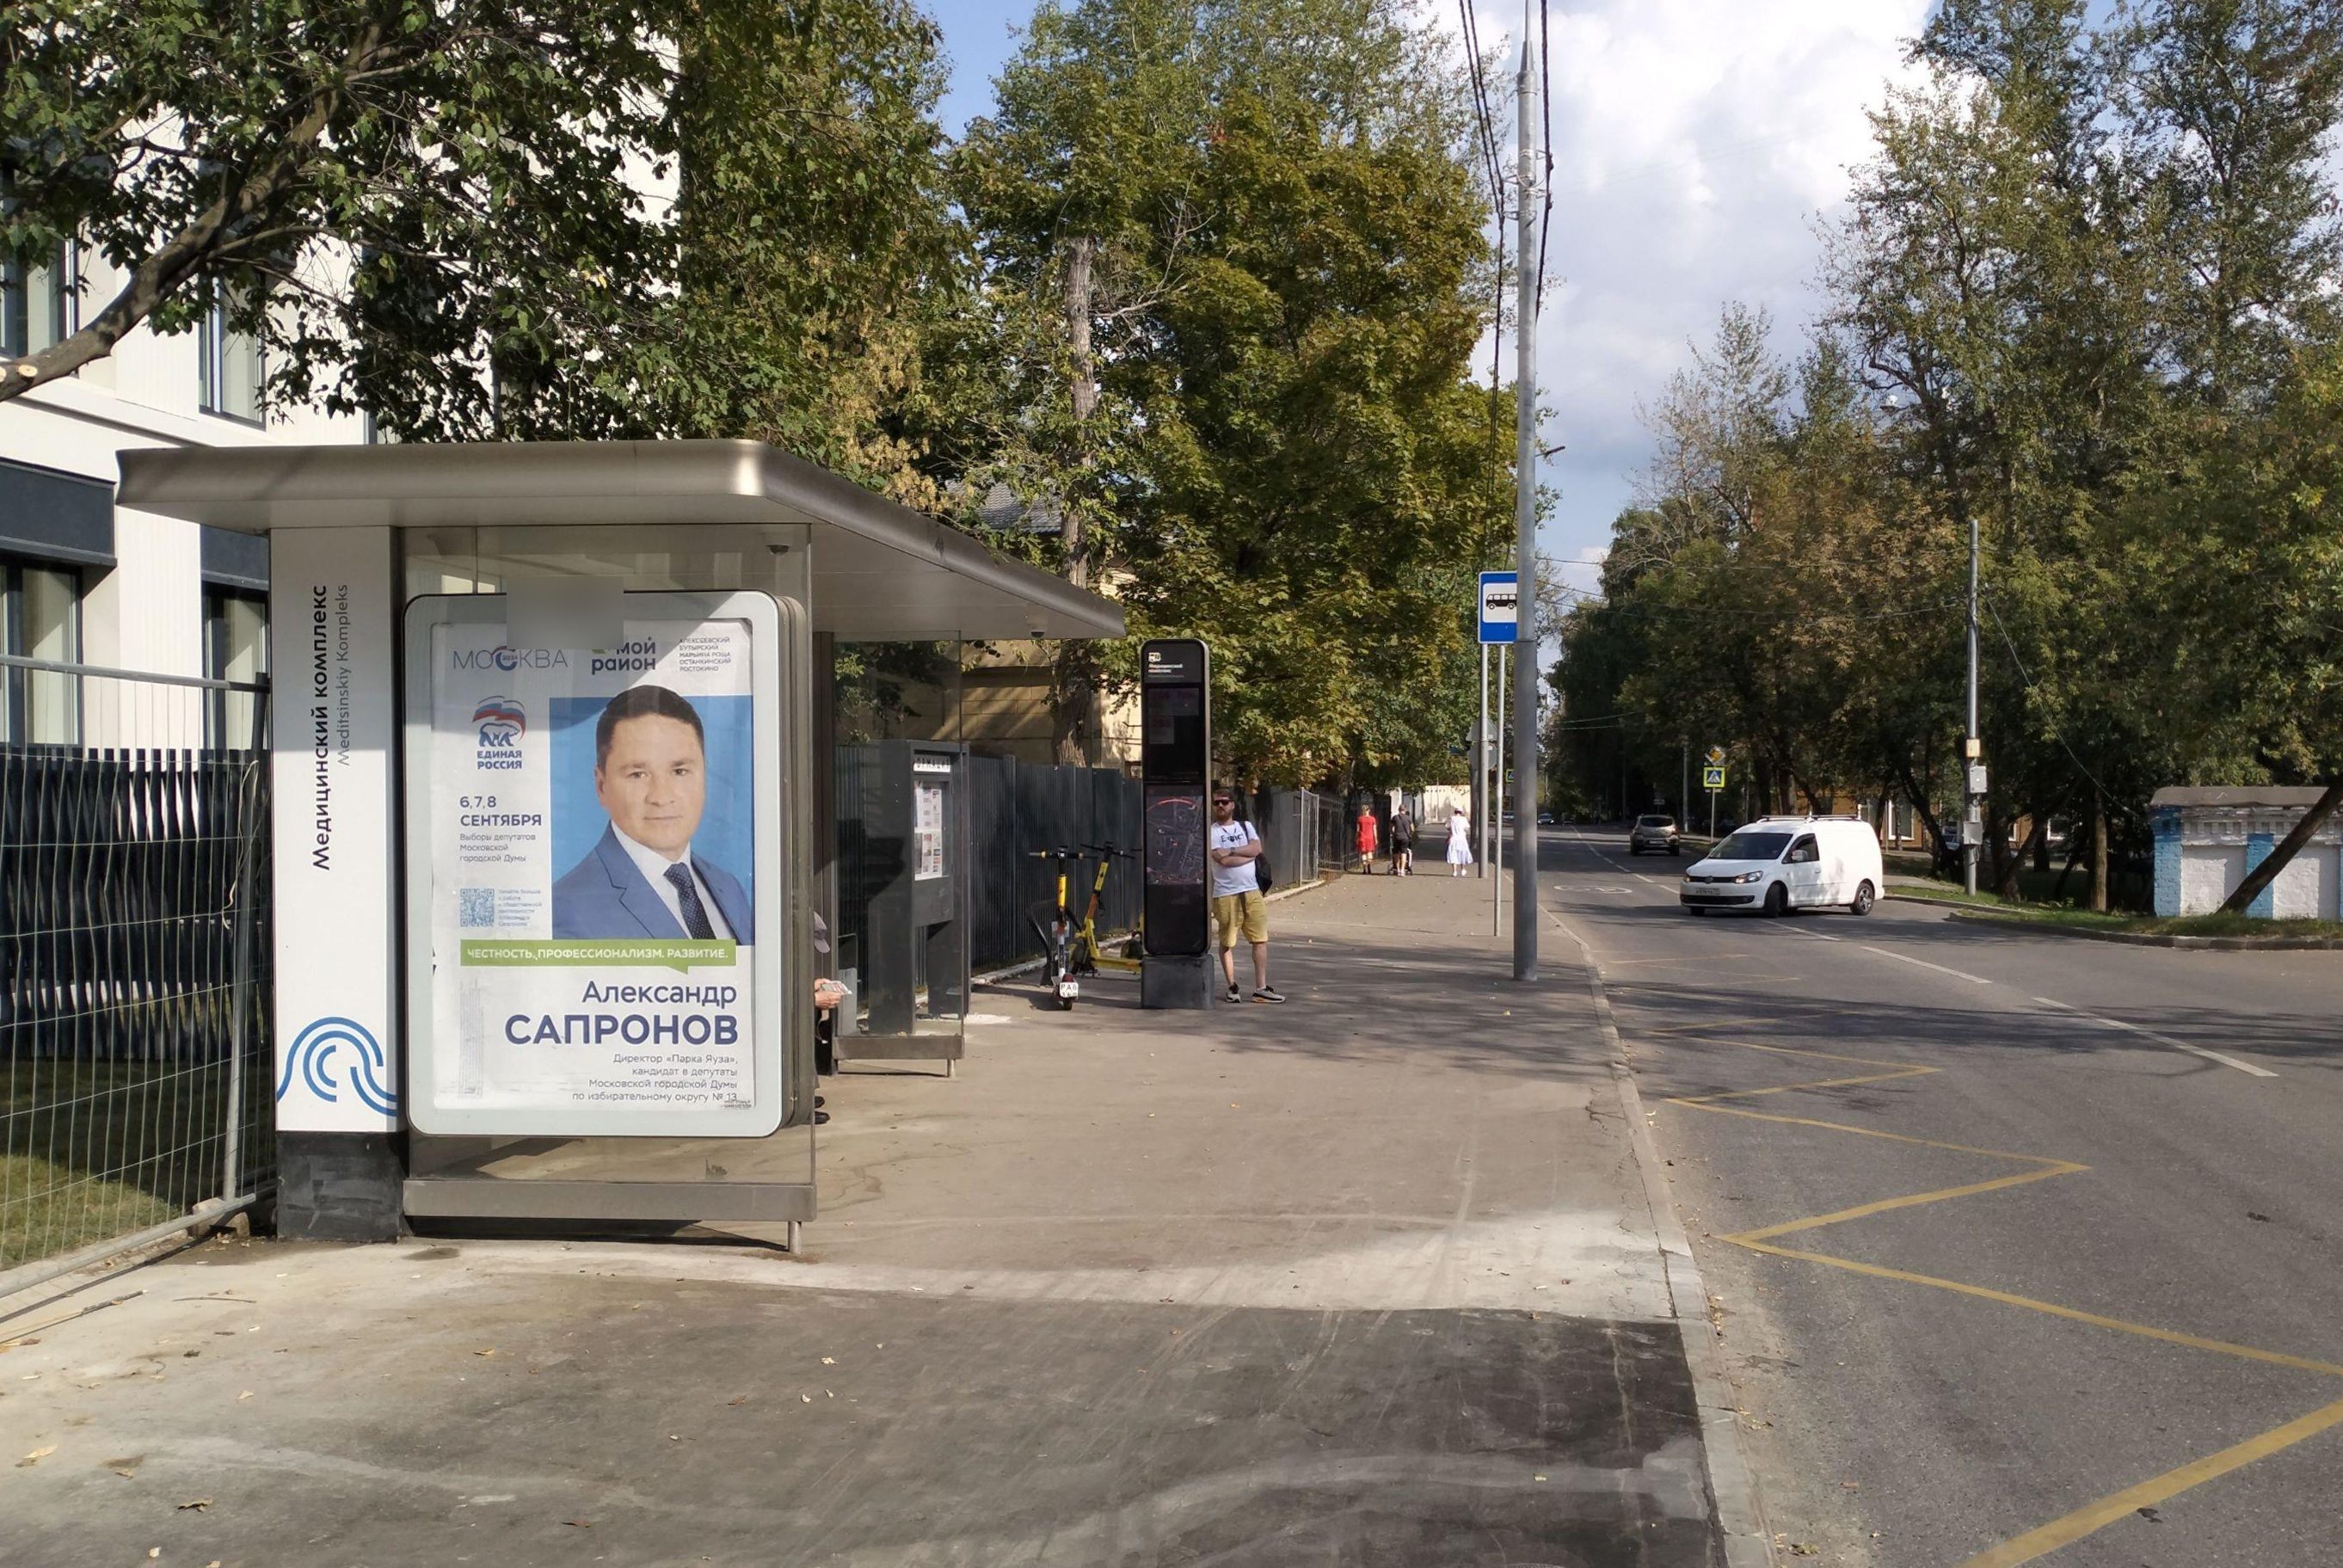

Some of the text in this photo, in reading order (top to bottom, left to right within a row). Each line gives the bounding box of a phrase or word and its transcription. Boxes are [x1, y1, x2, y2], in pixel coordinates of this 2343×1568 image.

[453, 646, 569, 671] МОСКВА
[335, 584, 351, 766] Meditsinskiy Kompleks
[311, 585, 332, 870] Медицинский комплекс
[477, 750, 522, 759] ЕДИНАЯ
[477, 760, 522, 770] РОССИЯ
[460, 814, 542, 827] СЕНТЯБРЯ
[459, 833, 537, 842] Выборы депутатов
[459, 843, 508, 852] Московской
[459, 854, 526, 863] городской Думы
[467, 947, 729, 959] ЧЕСТНОСТЬ. ПРОФЕССИОНАЛИЗМ. РАЗВИТИЕ.
[581, 981, 737, 1009] Александр
[504, 1014, 739, 1045] САПРОНОВ
[612, 1054, 738, 1065] Директор «Парка Яуза»,
[631, 1067, 680, 1077] кандидат
[691, 1068, 738, 1078] депутаты
[588, 1079, 738, 1091] Московской городской Думы
[587, 1091, 672, 1103] избирательному
[674, 1094, 709, 1103] округу
[712, 1092, 723, 1102] №
[726, 1092, 737, 1102] 13
